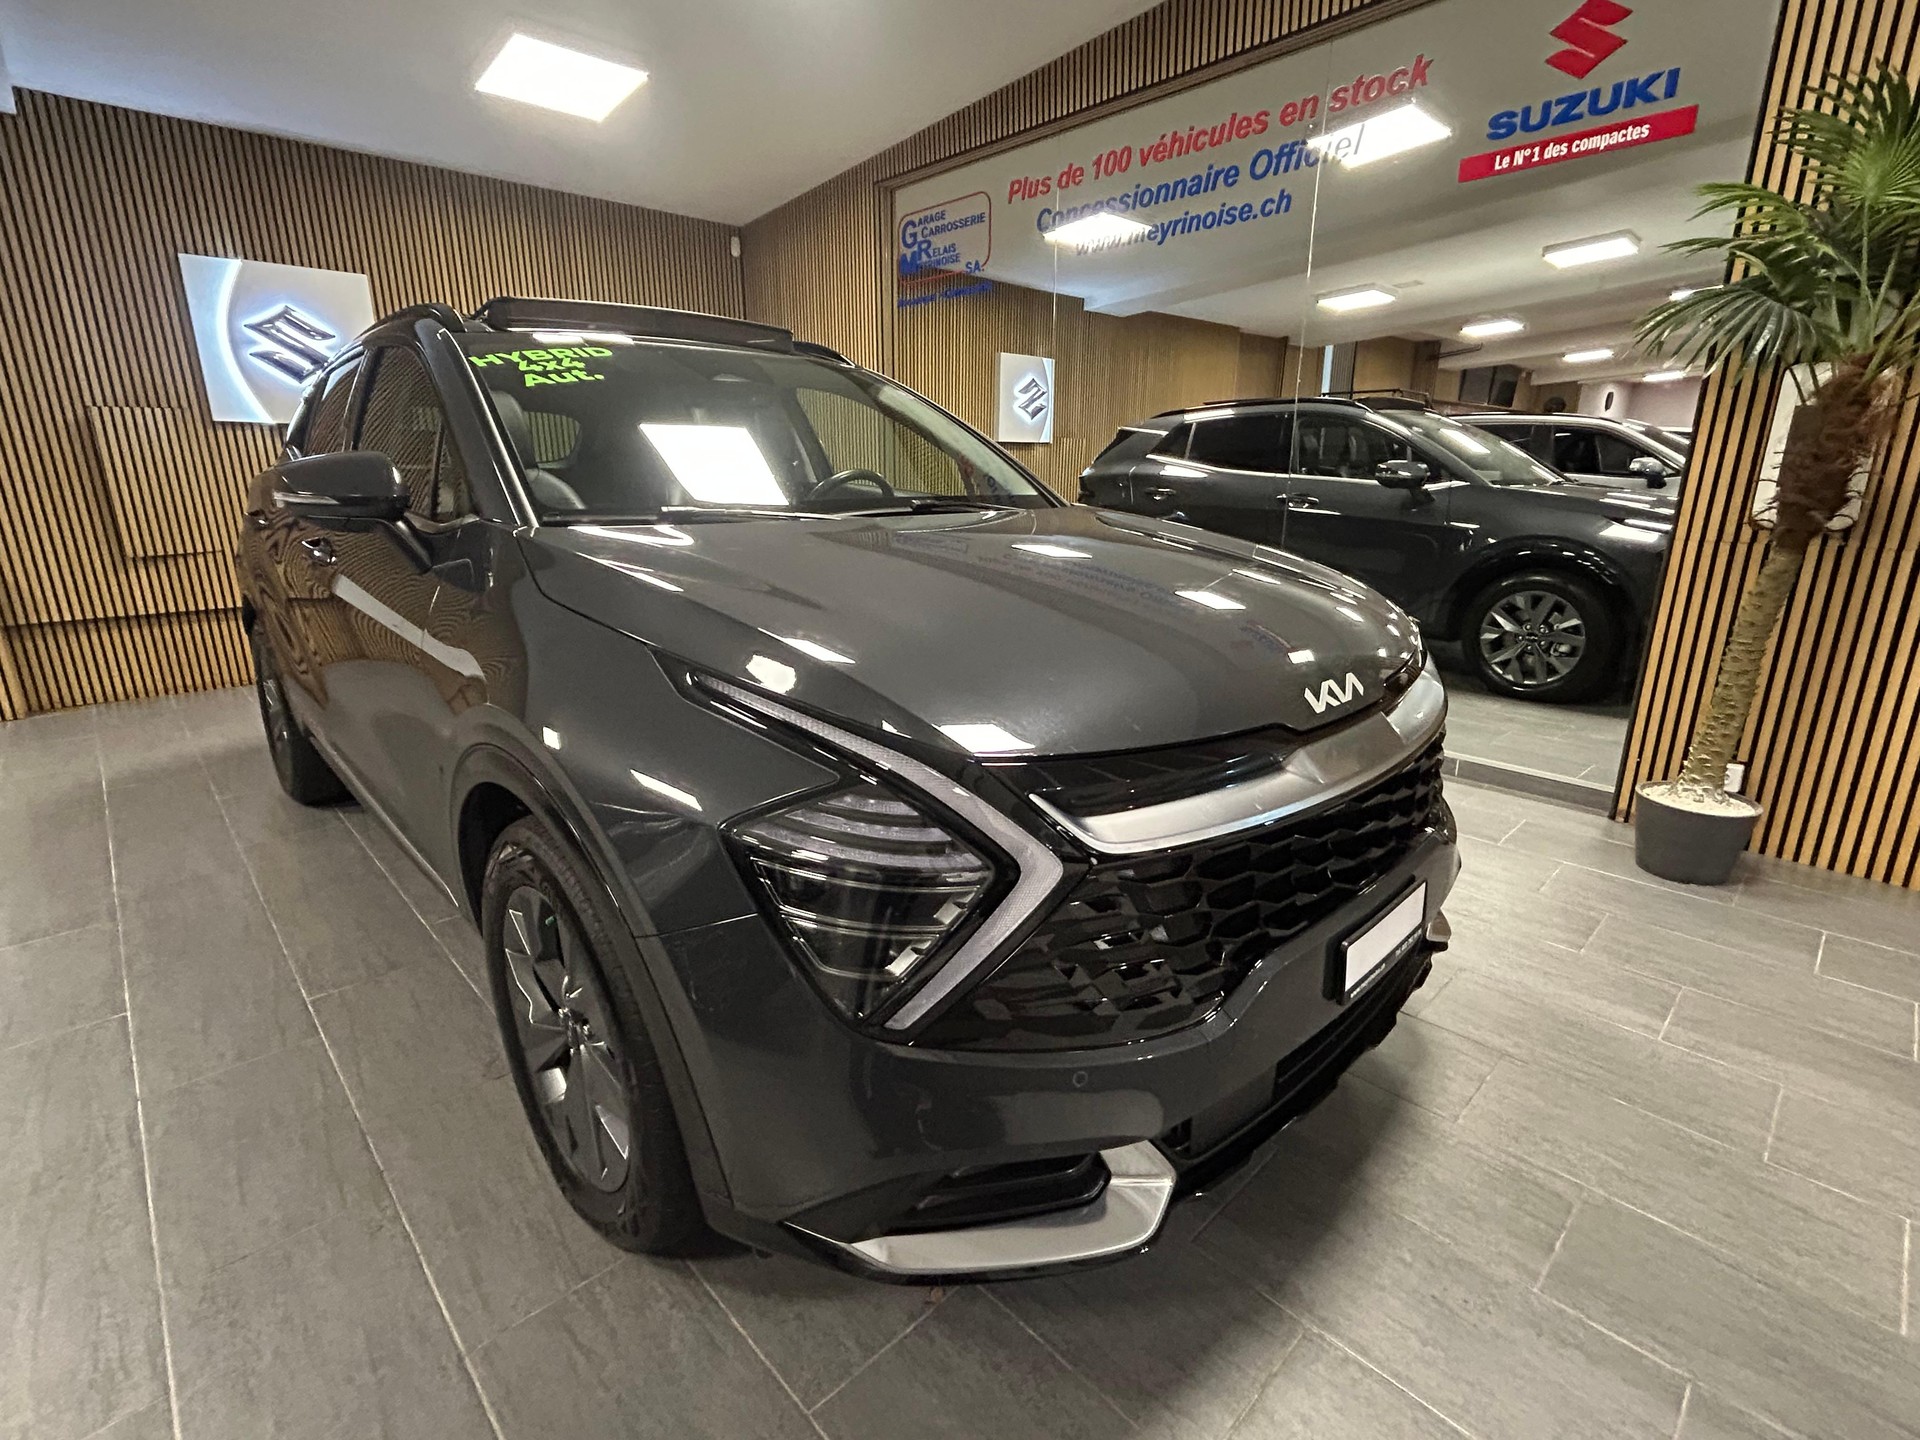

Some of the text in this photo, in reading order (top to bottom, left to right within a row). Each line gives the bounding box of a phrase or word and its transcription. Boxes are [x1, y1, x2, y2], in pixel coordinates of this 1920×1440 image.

[1486, 68, 1681, 140] SUZUKI
[1008, 53, 1434, 204] Plus de 100 véhicules en stock
[1494, 154, 1510, 171] Le
[1543, 141, 1568, 160] des
[1571, 123, 1651, 154] compactes
[1250, 123, 1365, 180] Officiel
[901, 210, 947, 249] GARAGE
[467, 346, 614, 367] HYBRID
[518, 357, 586, 372] 4x4
[524, 369, 605, 387] Aut.
[1304, 672, 1364, 714] KIA
